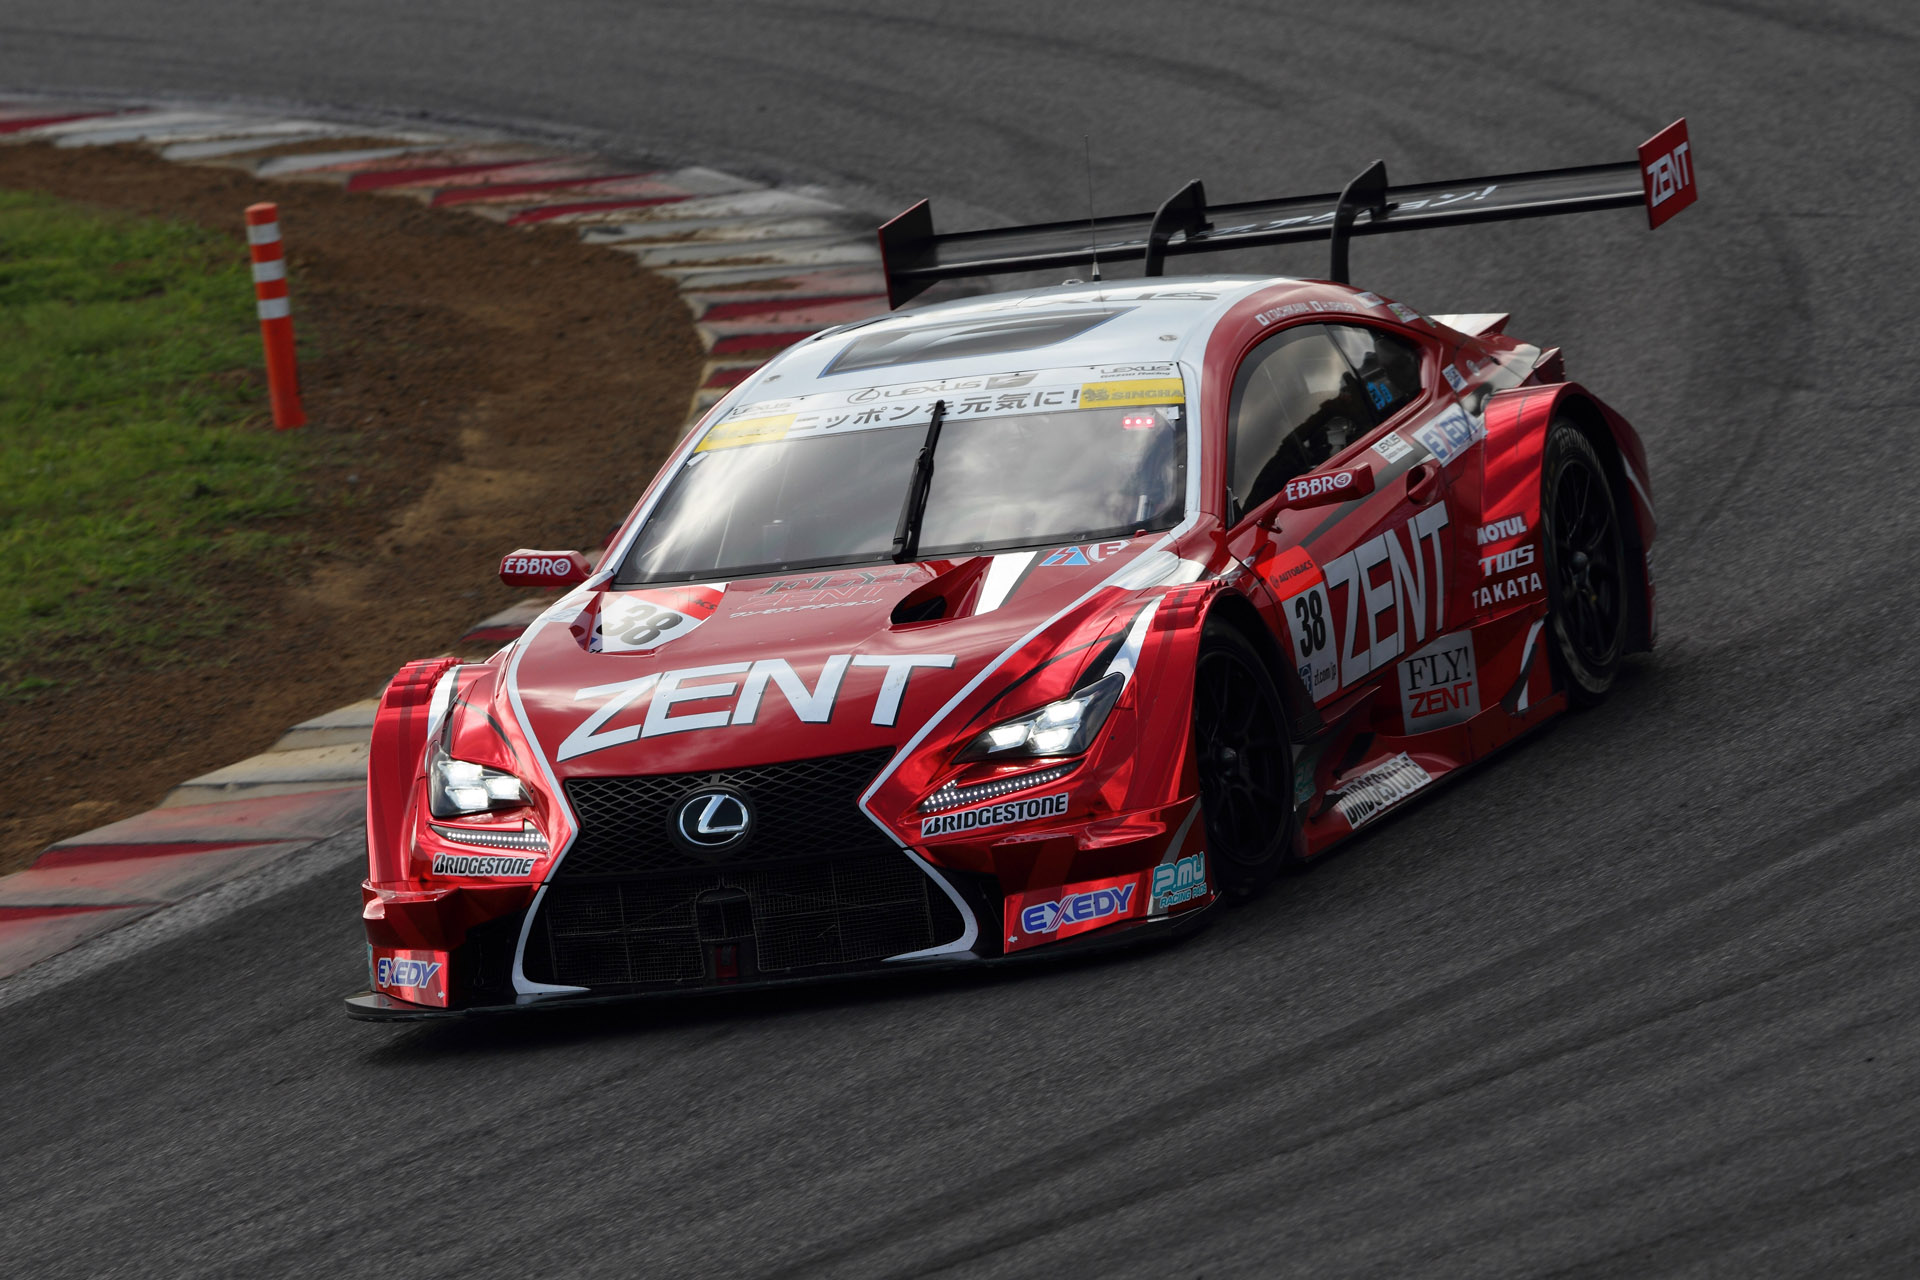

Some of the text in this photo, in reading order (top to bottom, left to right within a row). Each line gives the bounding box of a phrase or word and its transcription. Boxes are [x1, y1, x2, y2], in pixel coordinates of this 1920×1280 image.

[1646, 141, 1690, 208] ZENT
[1101, 365, 1171, 374] LEXUS
[884, 380, 982, 398] LEXUS
[1111, 388, 1185, 401] SINGHA
[788, 389, 1080, 430] ニッポンを元気に!
[1285, 472, 1352, 502] EBBRO
[1477, 515, 1527, 545] MOTUL
[504, 557, 571, 577] EBBRO
[1278, 559, 1314, 584] AUTOBACS
[1323, 500, 1449, 689] ZENT
[1472, 572, 1543, 609] TAKATA
[596, 604, 684, 646] 38
[1295, 590, 1327, 658] 38
[1405, 645, 1471, 692] FLY!
[557, 653, 957, 763] ZENT
[1409, 681, 1473, 719] ZENT
[921, 793, 1069, 838] BRIDGESTONE
[433, 853, 536, 876] BRIDGESTONE
[1021, 883, 1137, 935] EXEDY
[1159, 889, 1192, 909] RACING
[377, 957, 442, 989] EXEDY
